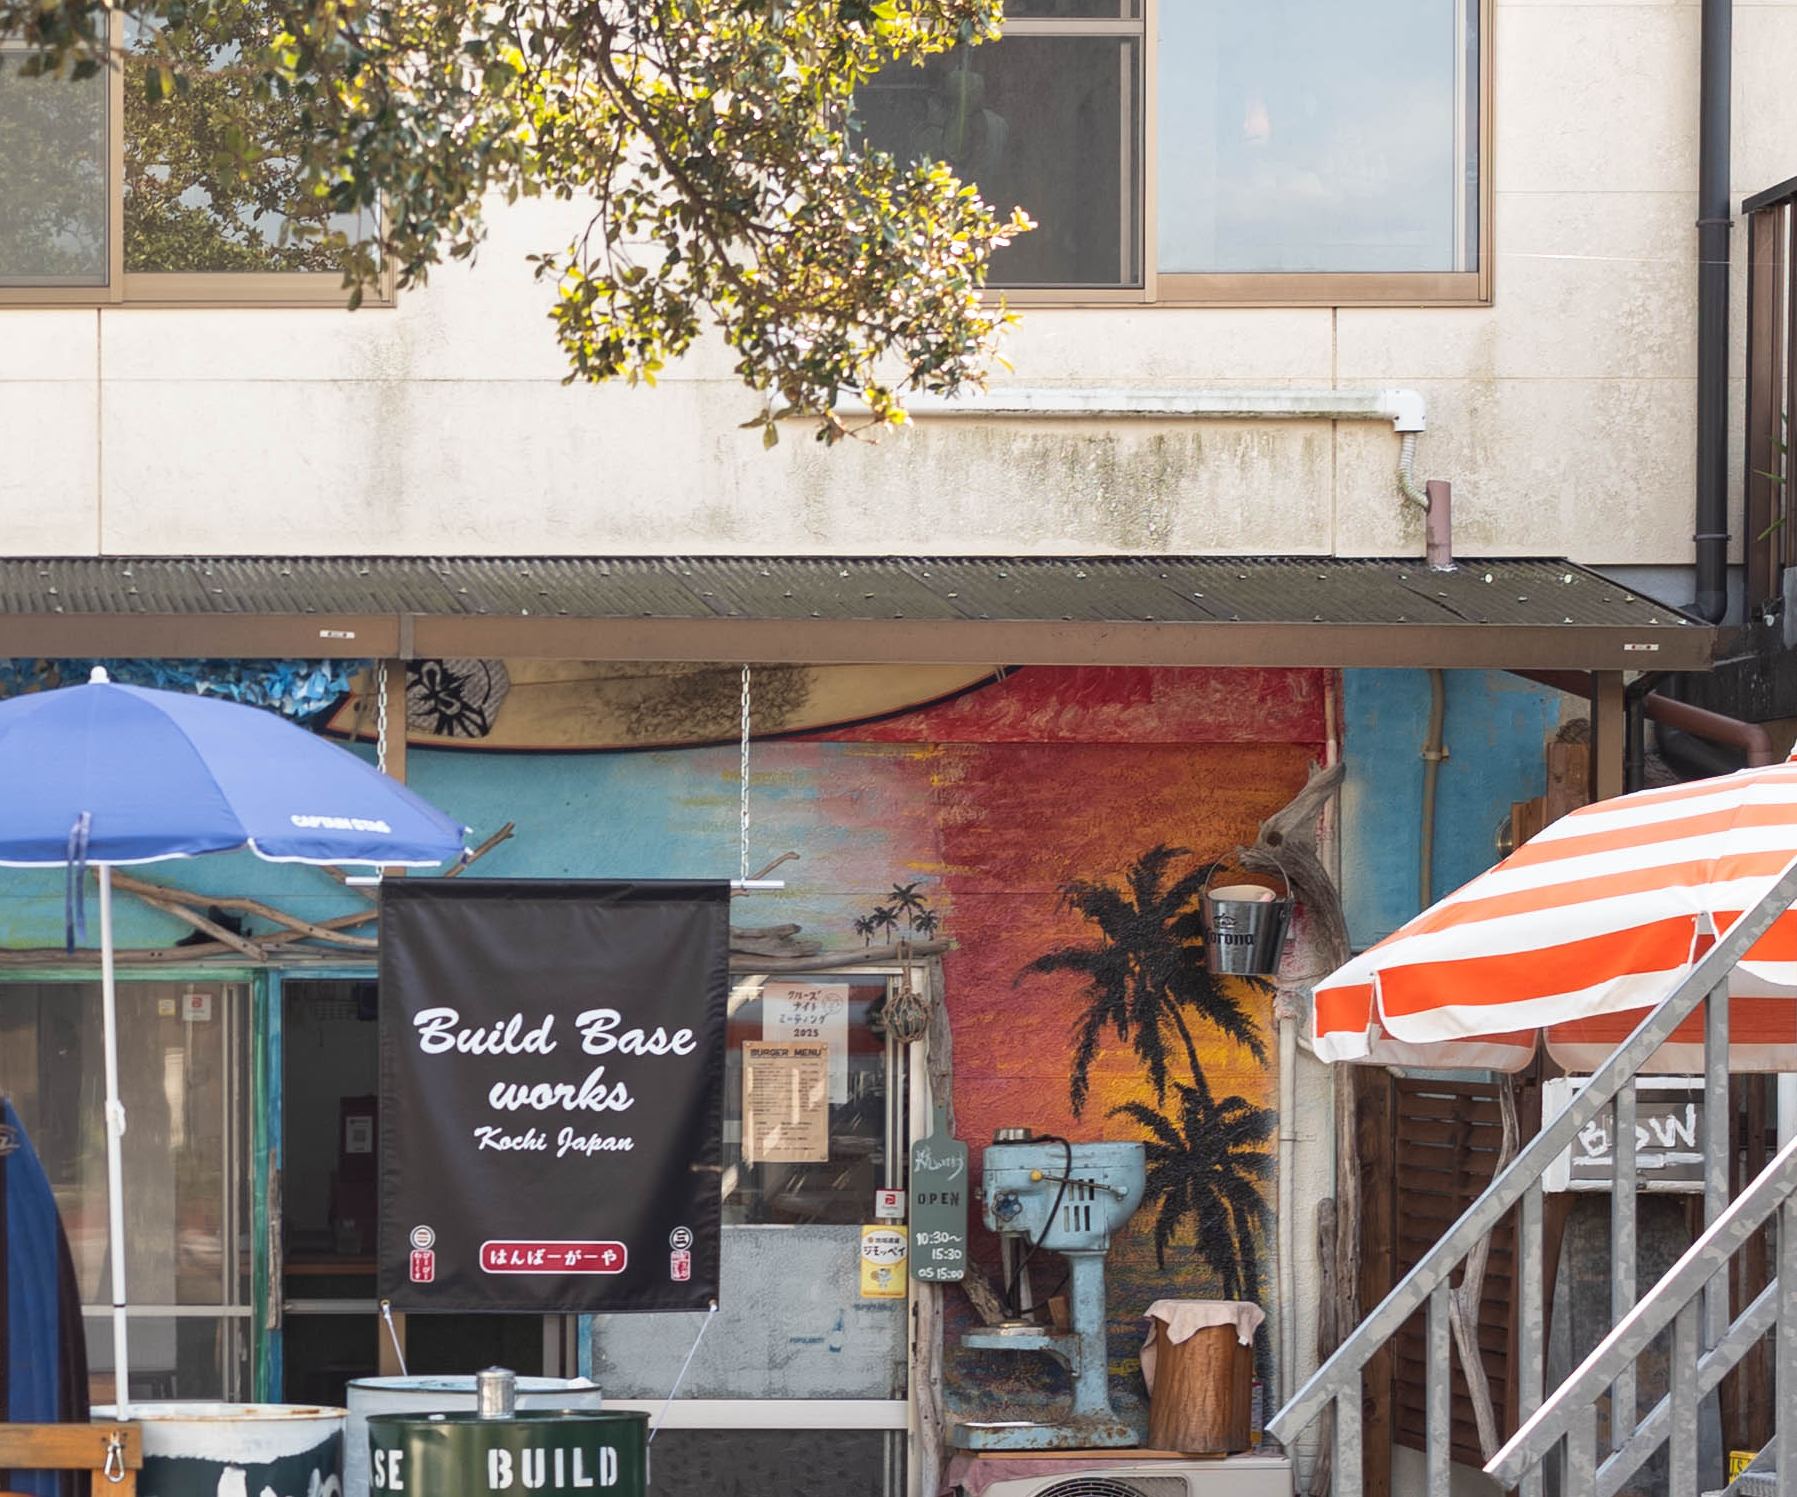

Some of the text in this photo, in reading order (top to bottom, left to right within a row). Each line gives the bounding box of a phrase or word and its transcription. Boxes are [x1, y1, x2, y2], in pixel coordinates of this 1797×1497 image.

[413, 1007, 697, 1055] Build Base
[793, 1028, 819, 1037] 2025
[488, 1065, 635, 1112] works
[473, 1126, 635, 1158] Kochi Japan
[917, 1192, 960, 1206] OPEN
[489, 1248, 618, 1266] はんばーがーや
[932, 1248, 962, 1260] 15:30
[937, 1268, 964, 1280] 15:00
[370, 1446, 619, 1491] SE BUILD
